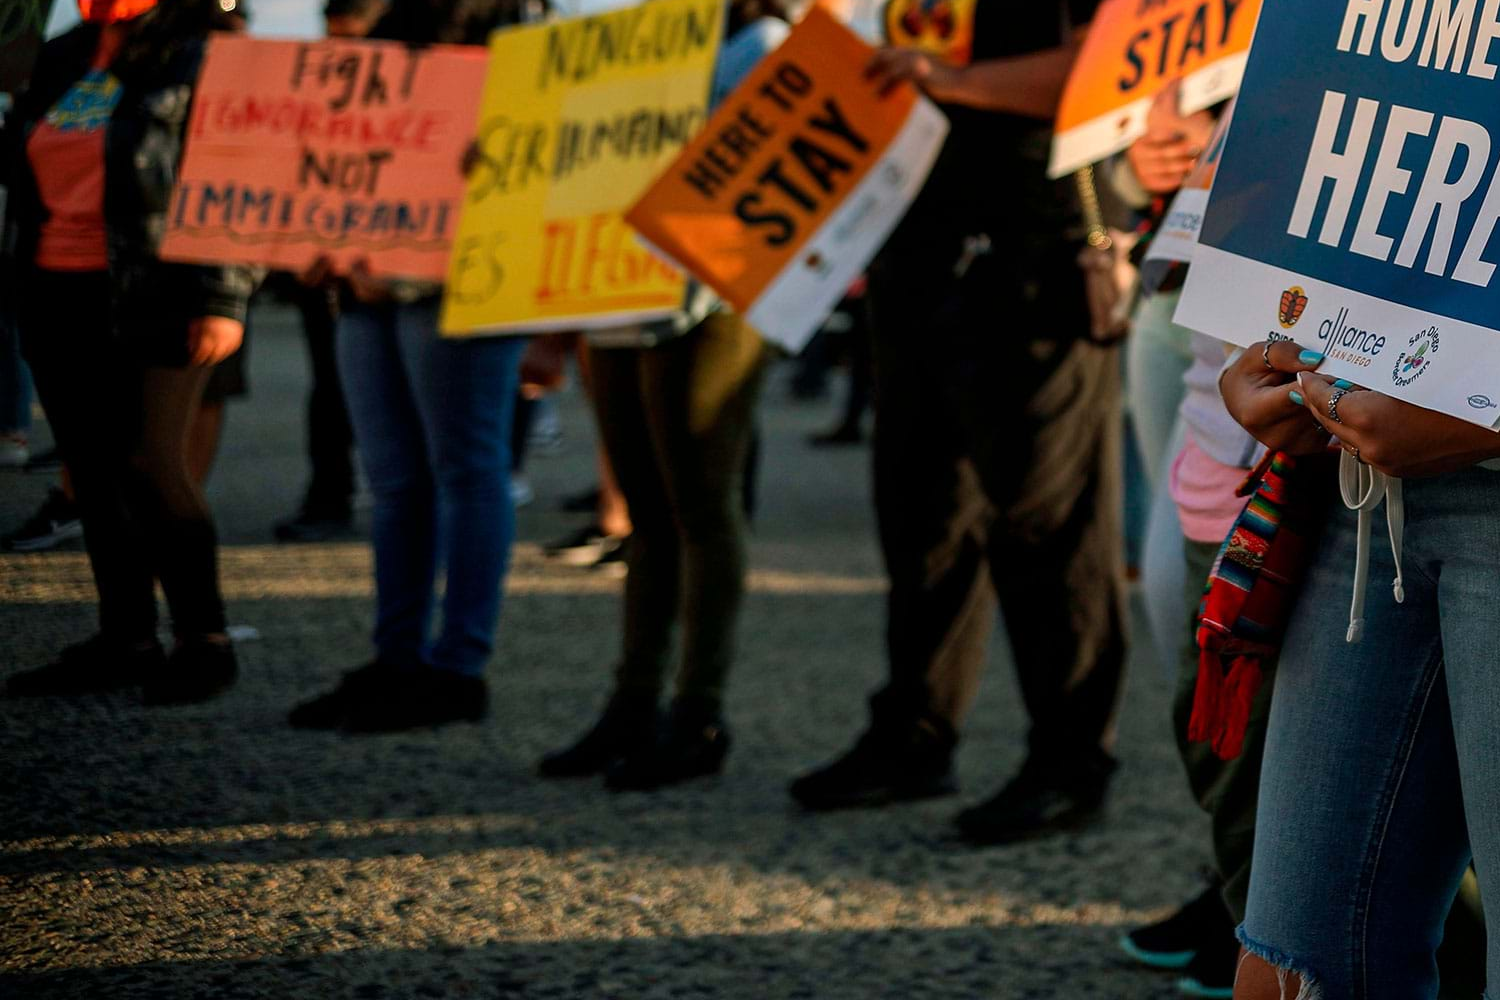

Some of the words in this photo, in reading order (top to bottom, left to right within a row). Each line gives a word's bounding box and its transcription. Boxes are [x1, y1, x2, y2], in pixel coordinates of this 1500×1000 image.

[682, 108, 773, 198] HERE
[758, 61, 814, 112] TO
[298, 146, 393, 196] NOT
[735, 97, 870, 247] STAY
[1317, 306, 1387, 358] alliance
[1408, 329, 1427, 347] San
[1330, 349, 1347, 362] SAN
[1348, 354, 1371, 368] DIEGO
